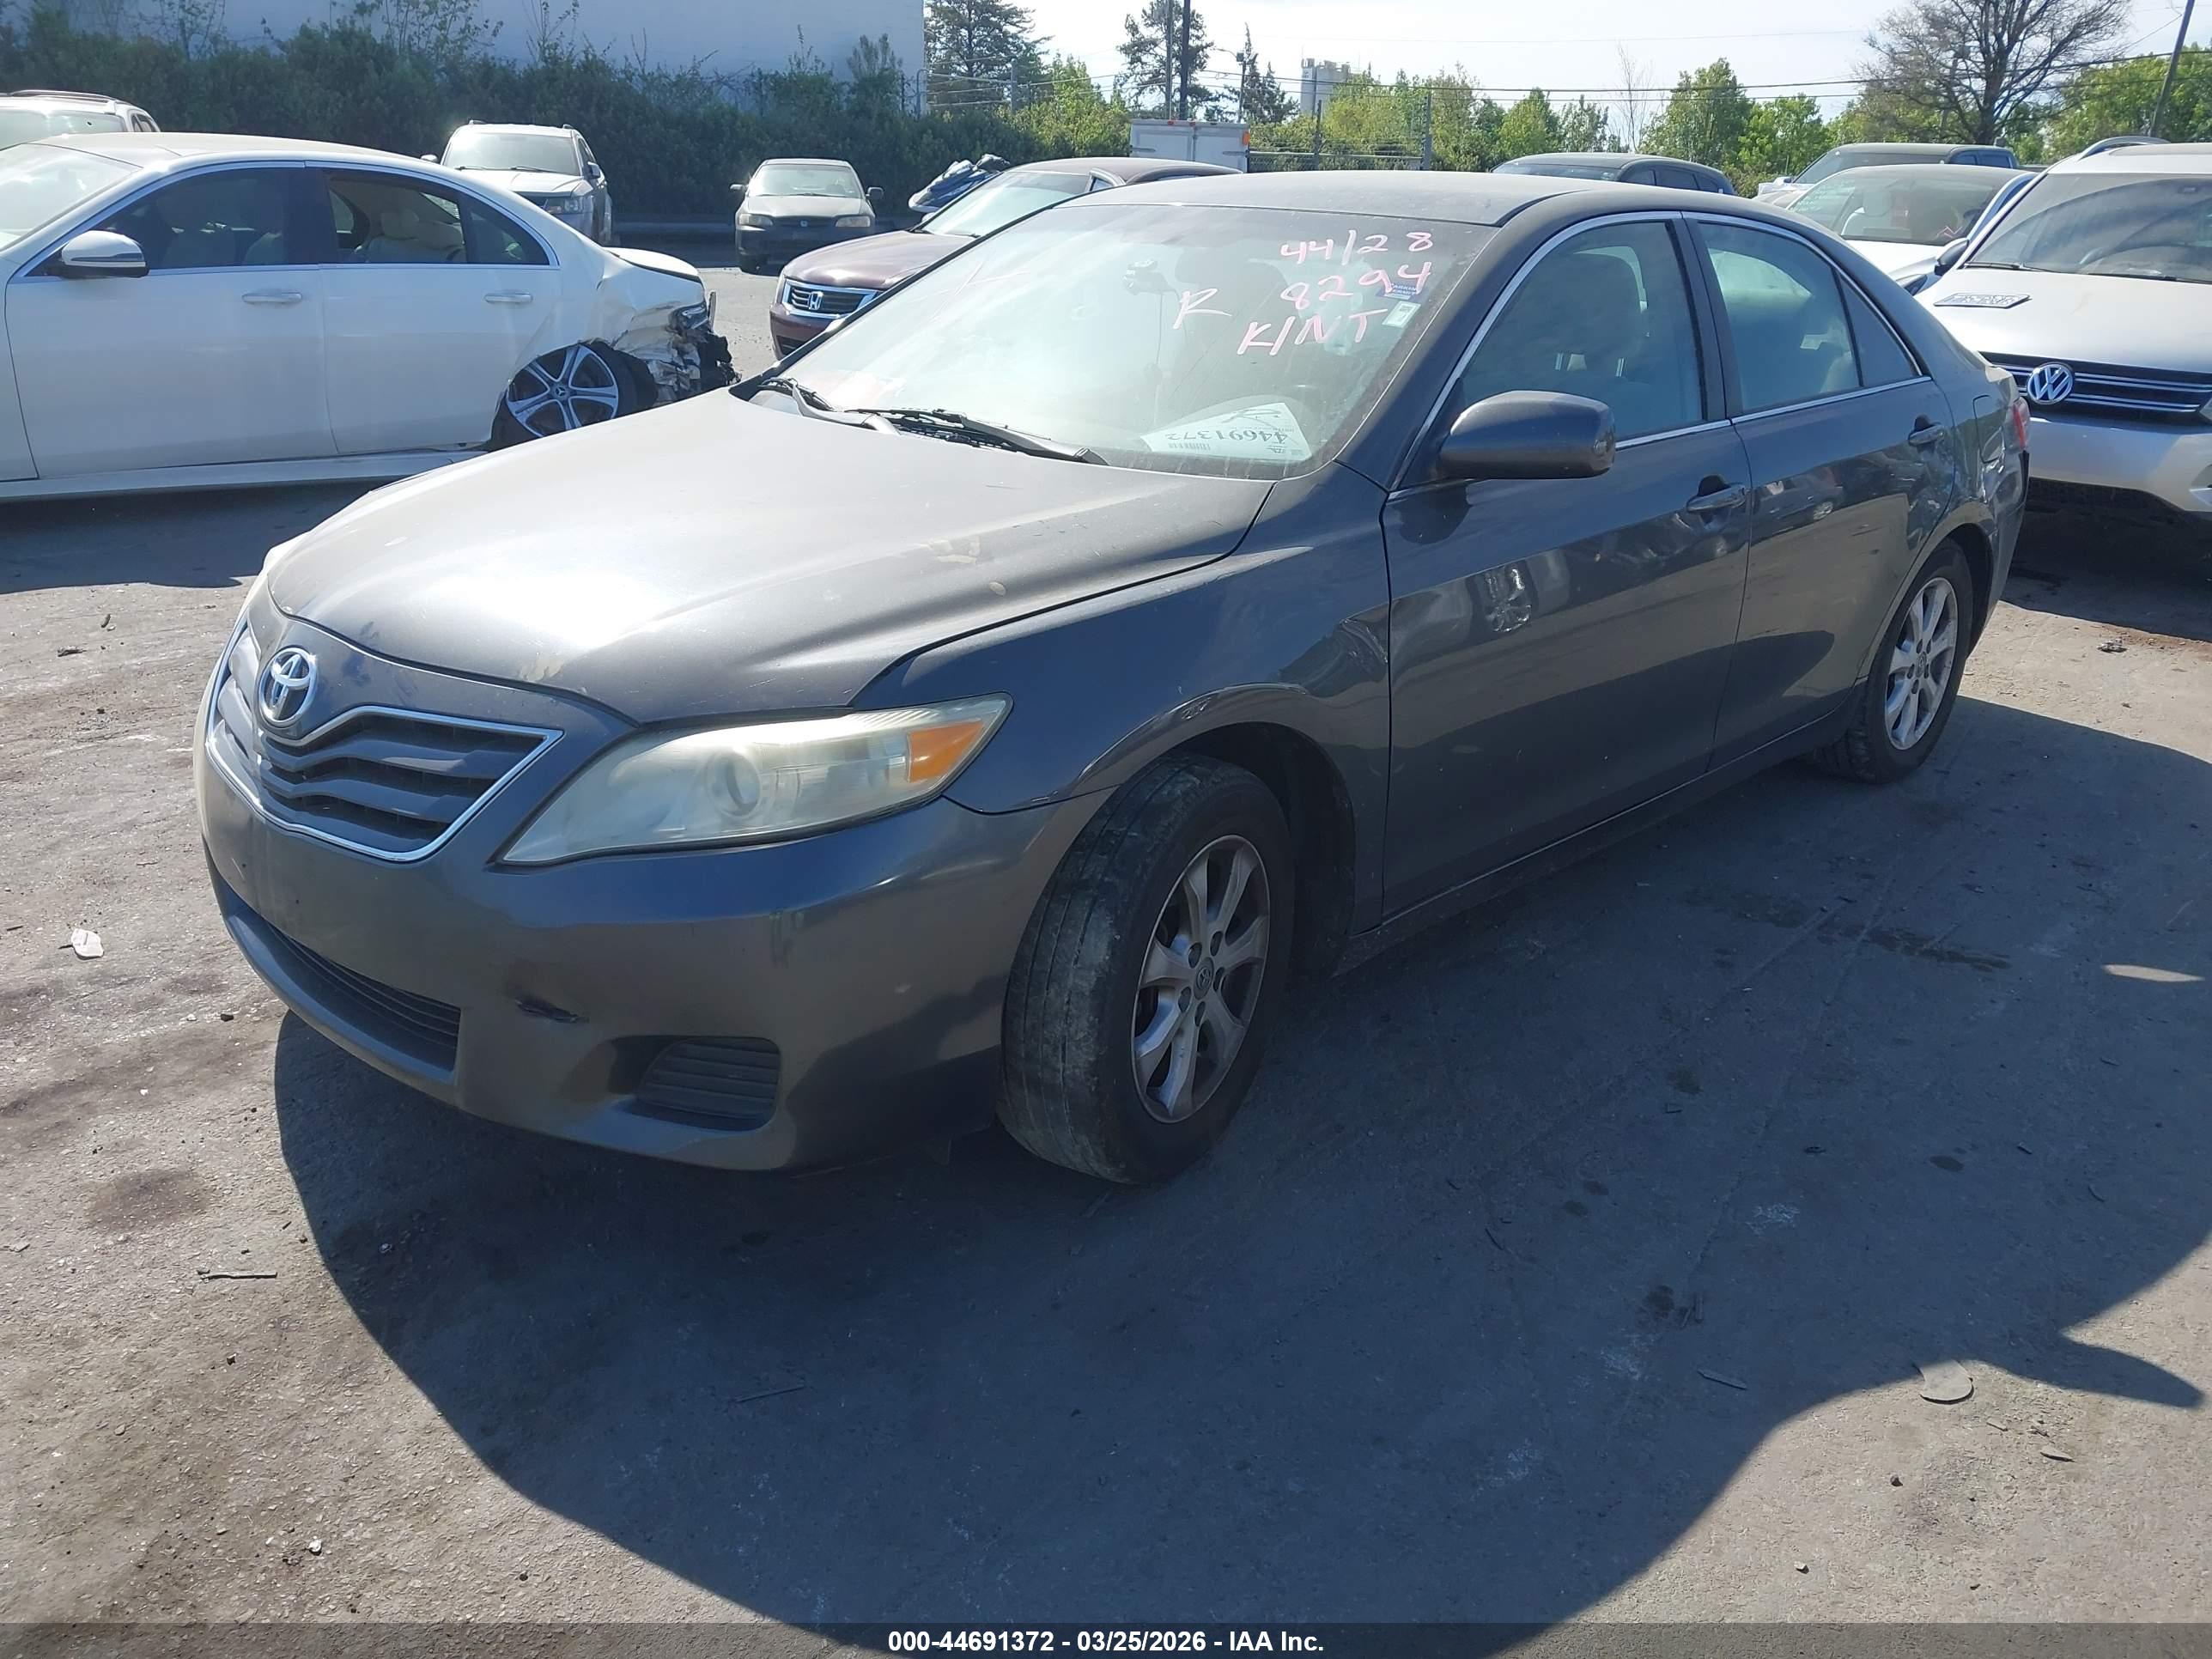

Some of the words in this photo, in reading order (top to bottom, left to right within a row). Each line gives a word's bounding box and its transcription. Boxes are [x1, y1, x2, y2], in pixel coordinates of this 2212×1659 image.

[1280, 261, 1432, 310] 8294
[1173, 288, 1232, 330] R
[2027, 362, 2073, 404] VW
[1165, 429, 1288, 444] 44691372
